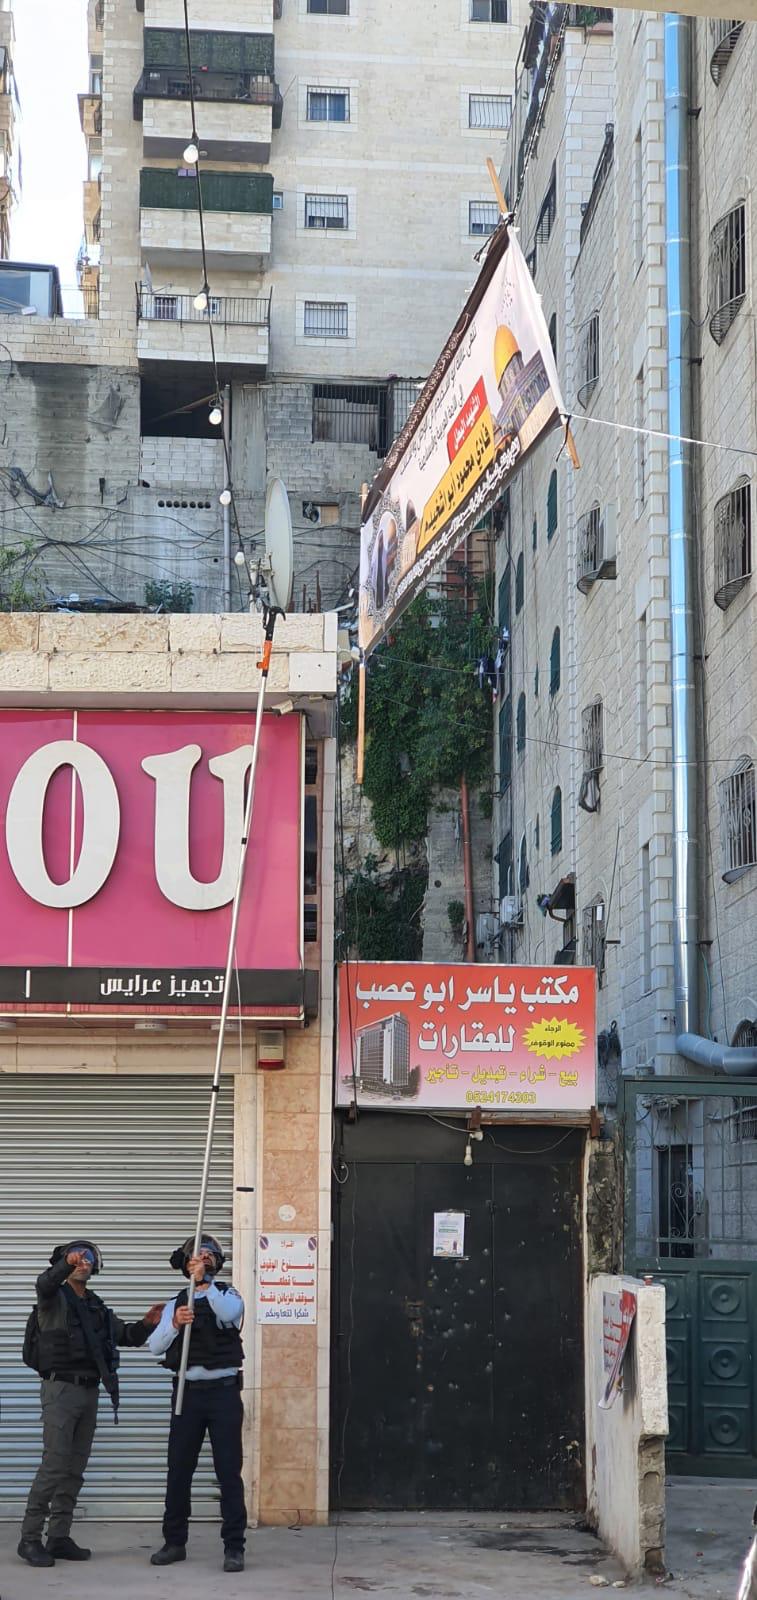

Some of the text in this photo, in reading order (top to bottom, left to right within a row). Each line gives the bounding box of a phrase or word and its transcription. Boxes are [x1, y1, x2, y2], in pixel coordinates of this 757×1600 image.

[475, 423, 491, 471] فادي
[456, 454, 475, 493] محمود
[100, 974, 225, 997] تجهيز عرايس
[356, 975, 579, 1014] مكتب ياسر ابو عصب
[418, 1021, 516, 1059] للعقارات
[545, 1025, 561, 1033] الرجاء
[529, 1040, 575, 1048] ممنوع الوقوف
[471, 1064, 507, 1085] تبديل
[519, 1063, 546, 1084] شراء
[559, 1069, 579, 1087] بيع
